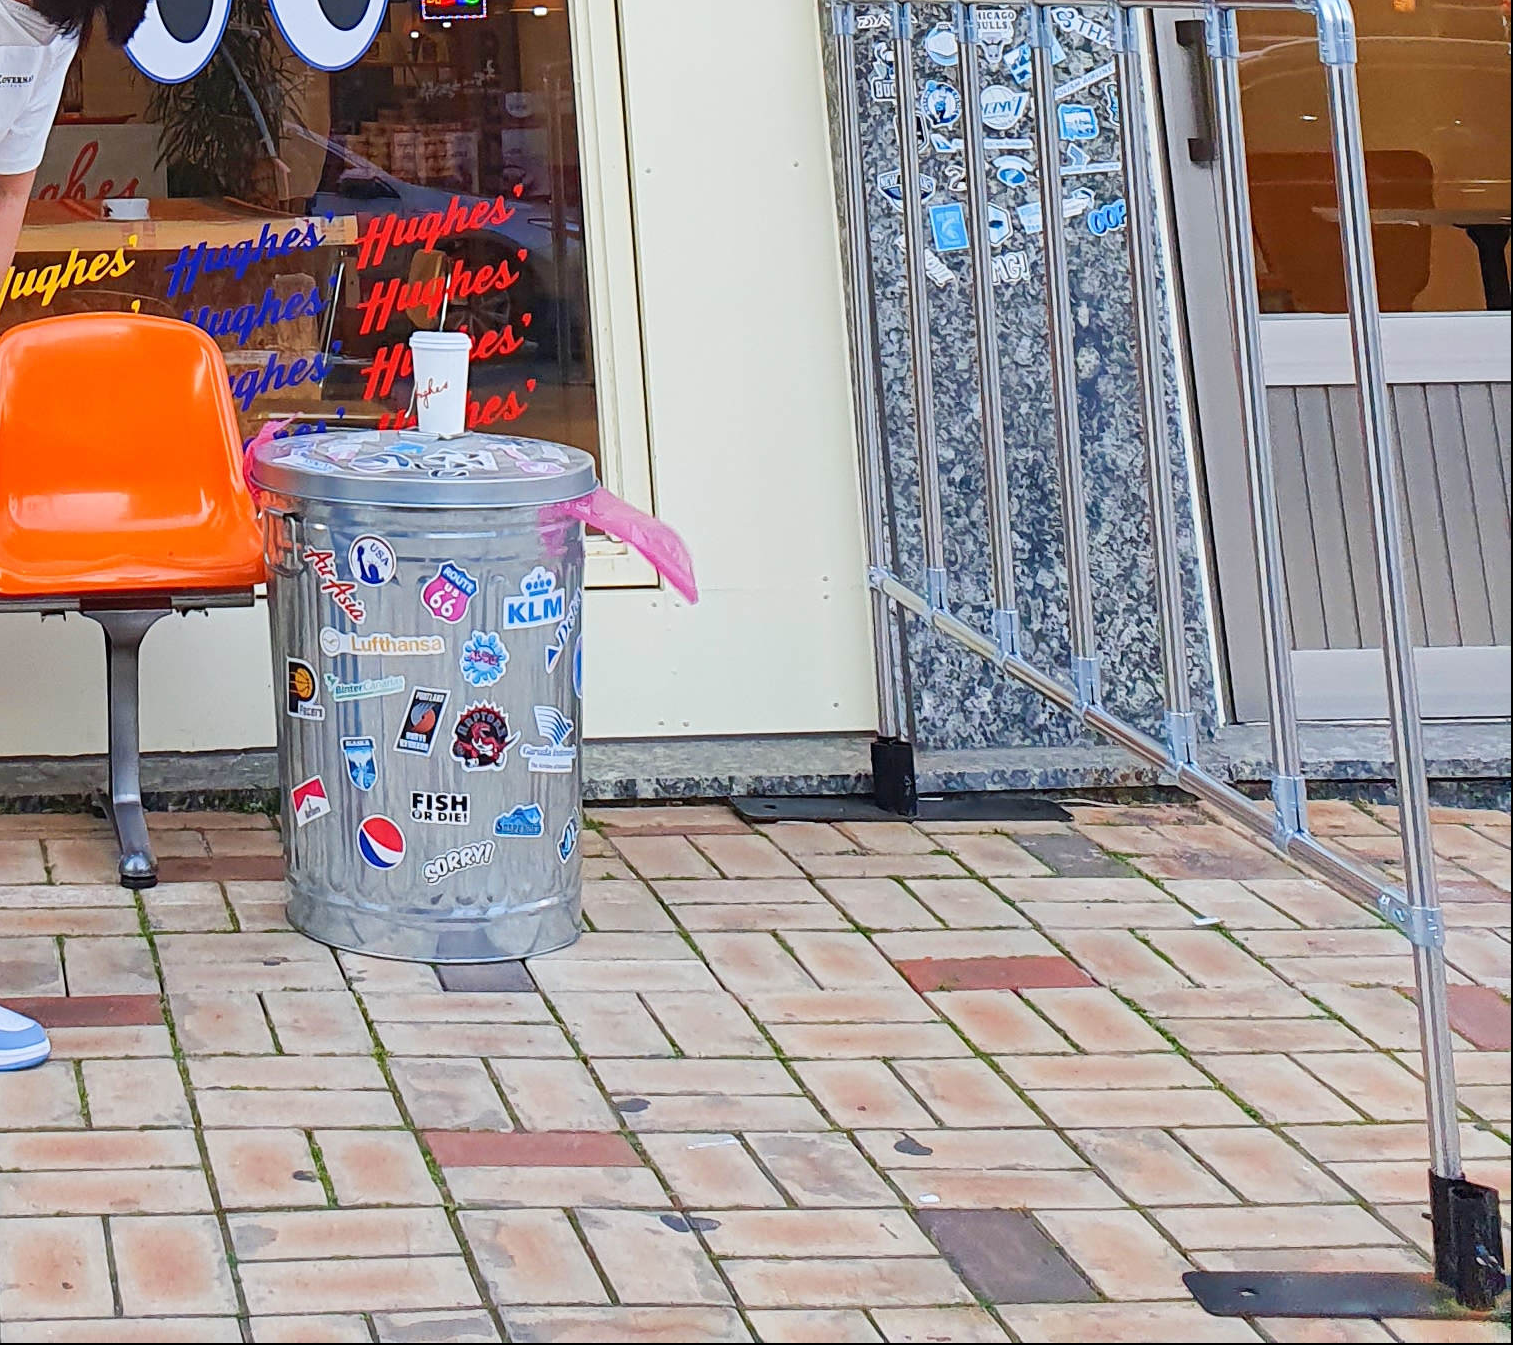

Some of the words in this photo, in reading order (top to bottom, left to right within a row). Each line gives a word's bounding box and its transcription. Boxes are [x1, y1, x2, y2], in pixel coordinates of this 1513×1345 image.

[976, 11, 1015, 21] HICAGO
[1078, 14, 1116, 45] THA
[992, 253, 1031, 285] MG!
[369, 542, 390, 567] USA
[303, 547, 335, 578] Air
[321, 579, 365, 622] Asia
[442, 565, 475, 594] ROUTE
[429, 589, 457, 618] 66
[507, 595, 563, 625] KLM
[350, 635, 443, 653] Lufthansa
[412, 792, 468, 812] FISH
[412, 810, 433, 820] OR
[437, 811, 468, 823] DIE!
[424, 842, 494, 884] SORRY!
